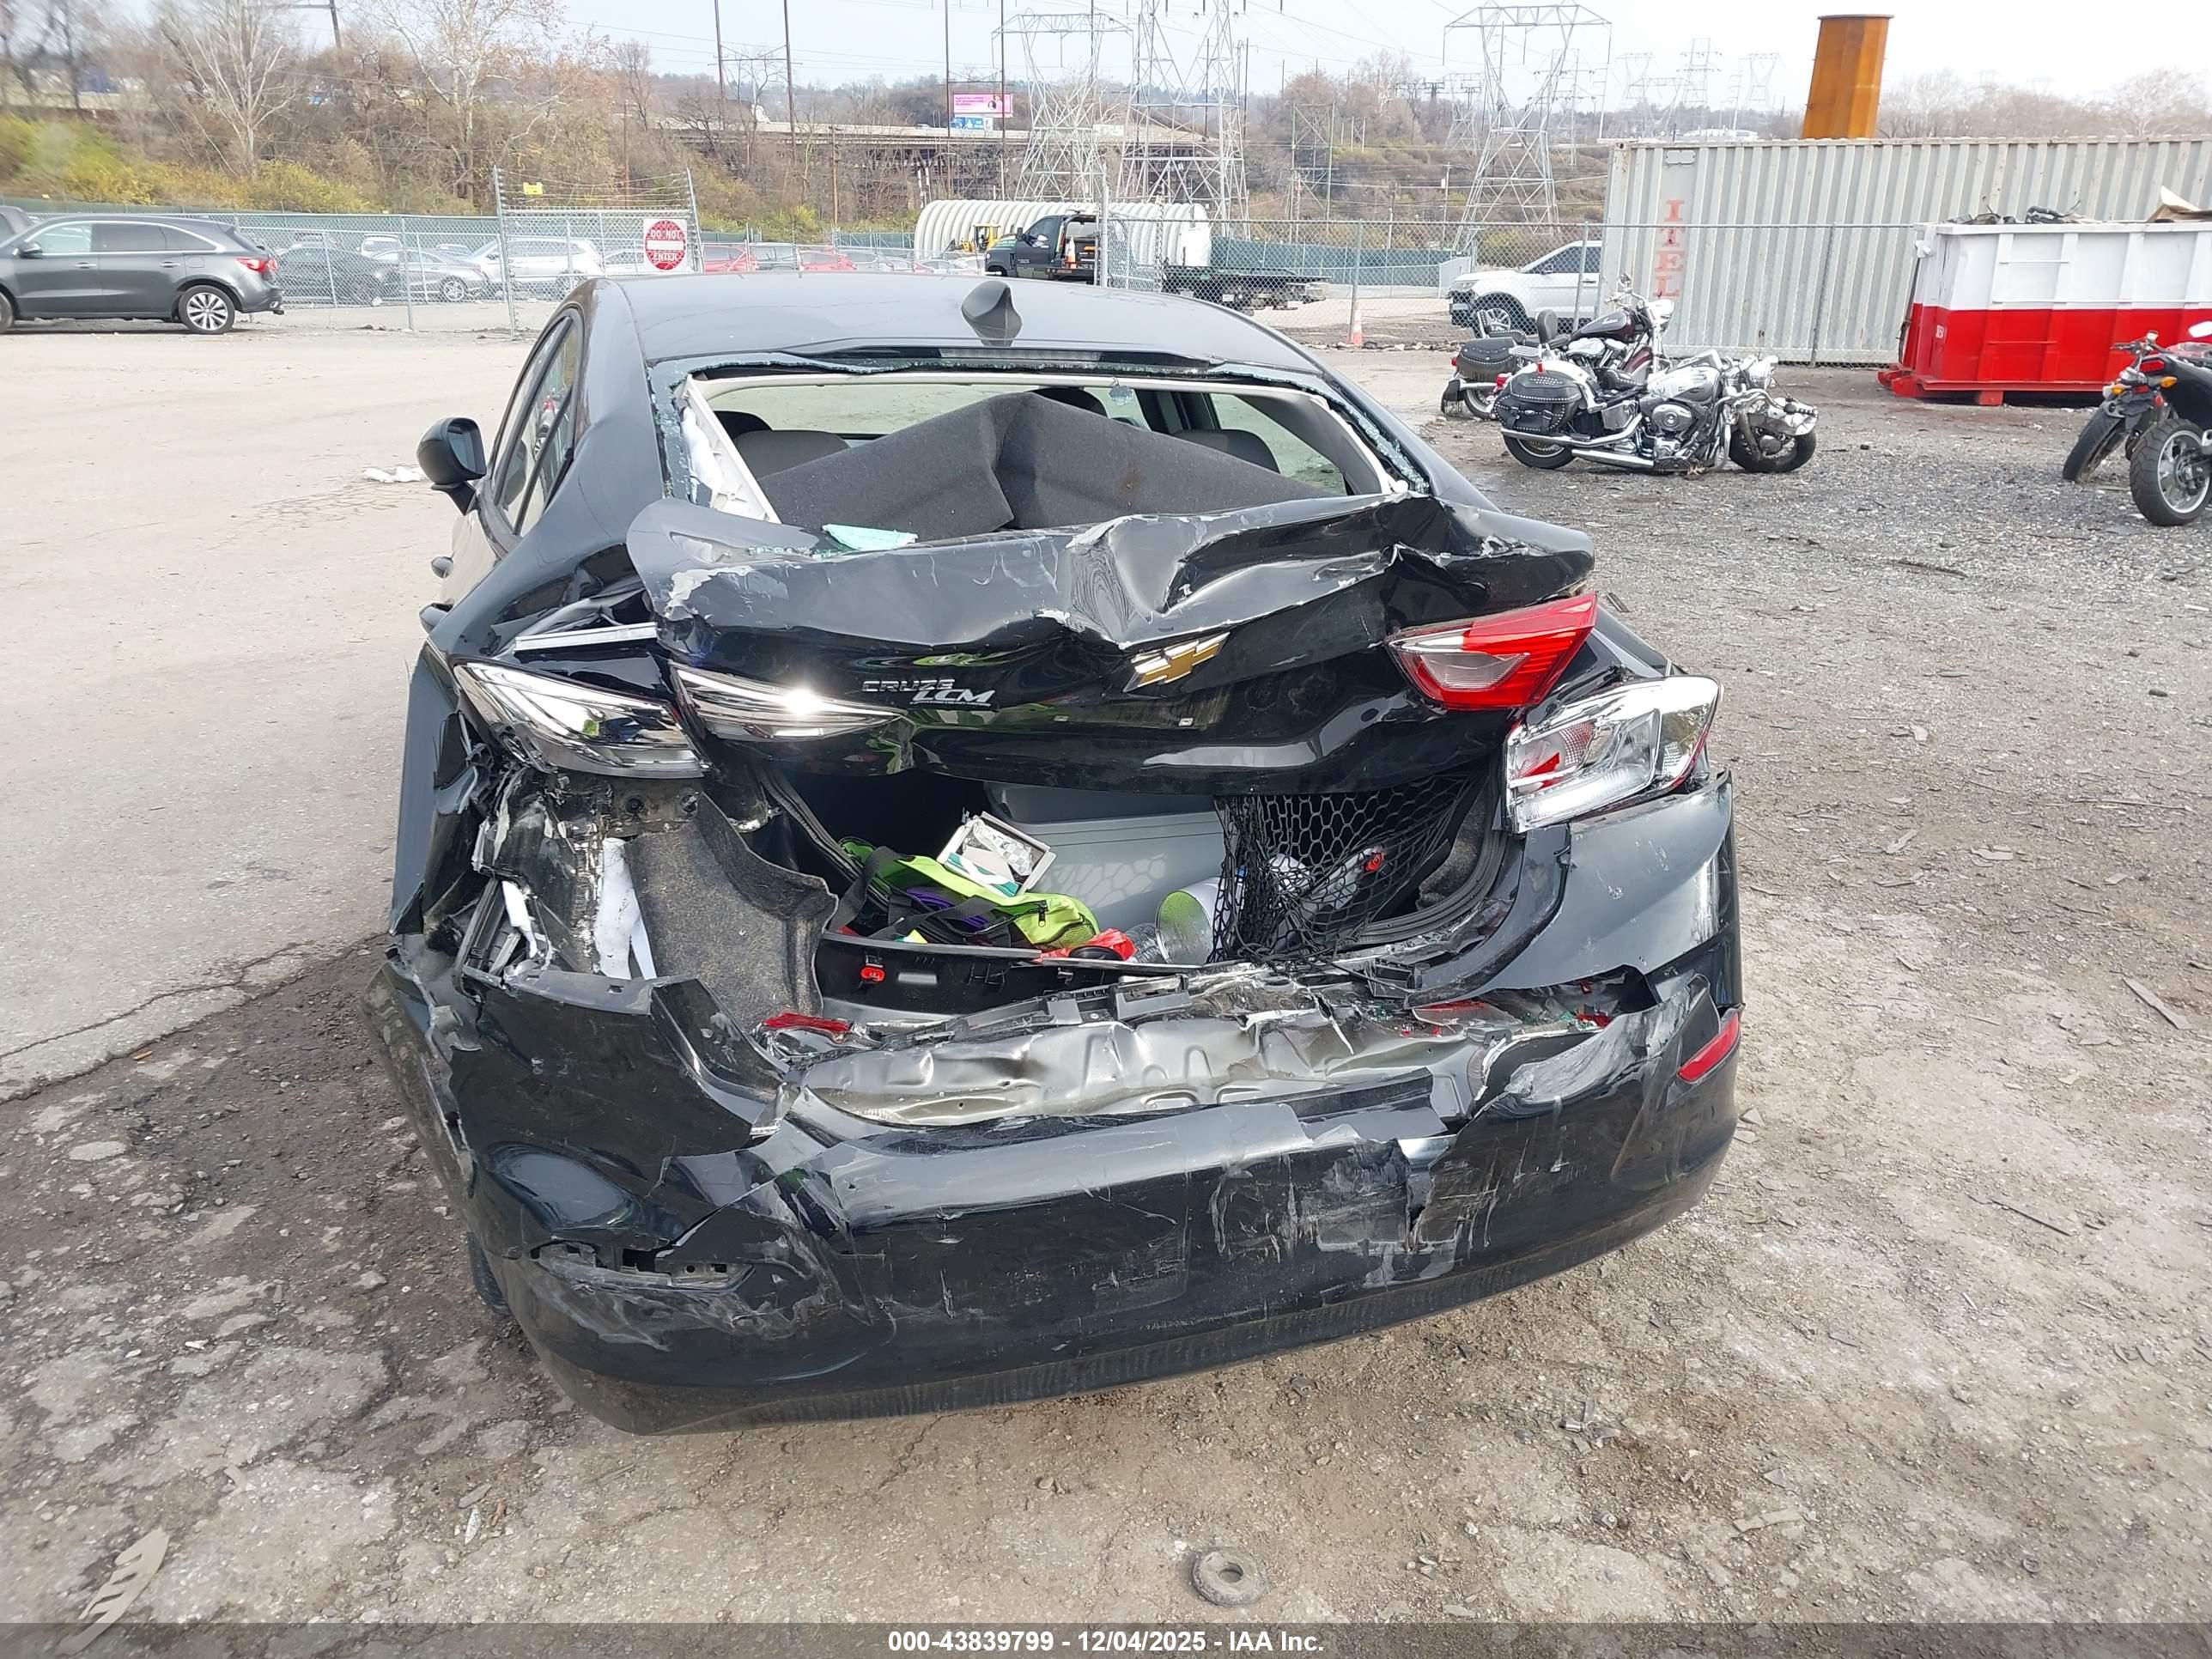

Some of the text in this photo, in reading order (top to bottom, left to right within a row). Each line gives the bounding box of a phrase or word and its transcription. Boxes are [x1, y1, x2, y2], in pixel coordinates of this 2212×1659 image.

[650, 229, 682, 240] DO NOT
[1653, 199, 1685, 297] ITEL
[653, 252, 678, 261] ENTER
[861, 678, 955, 692] CRUZE
